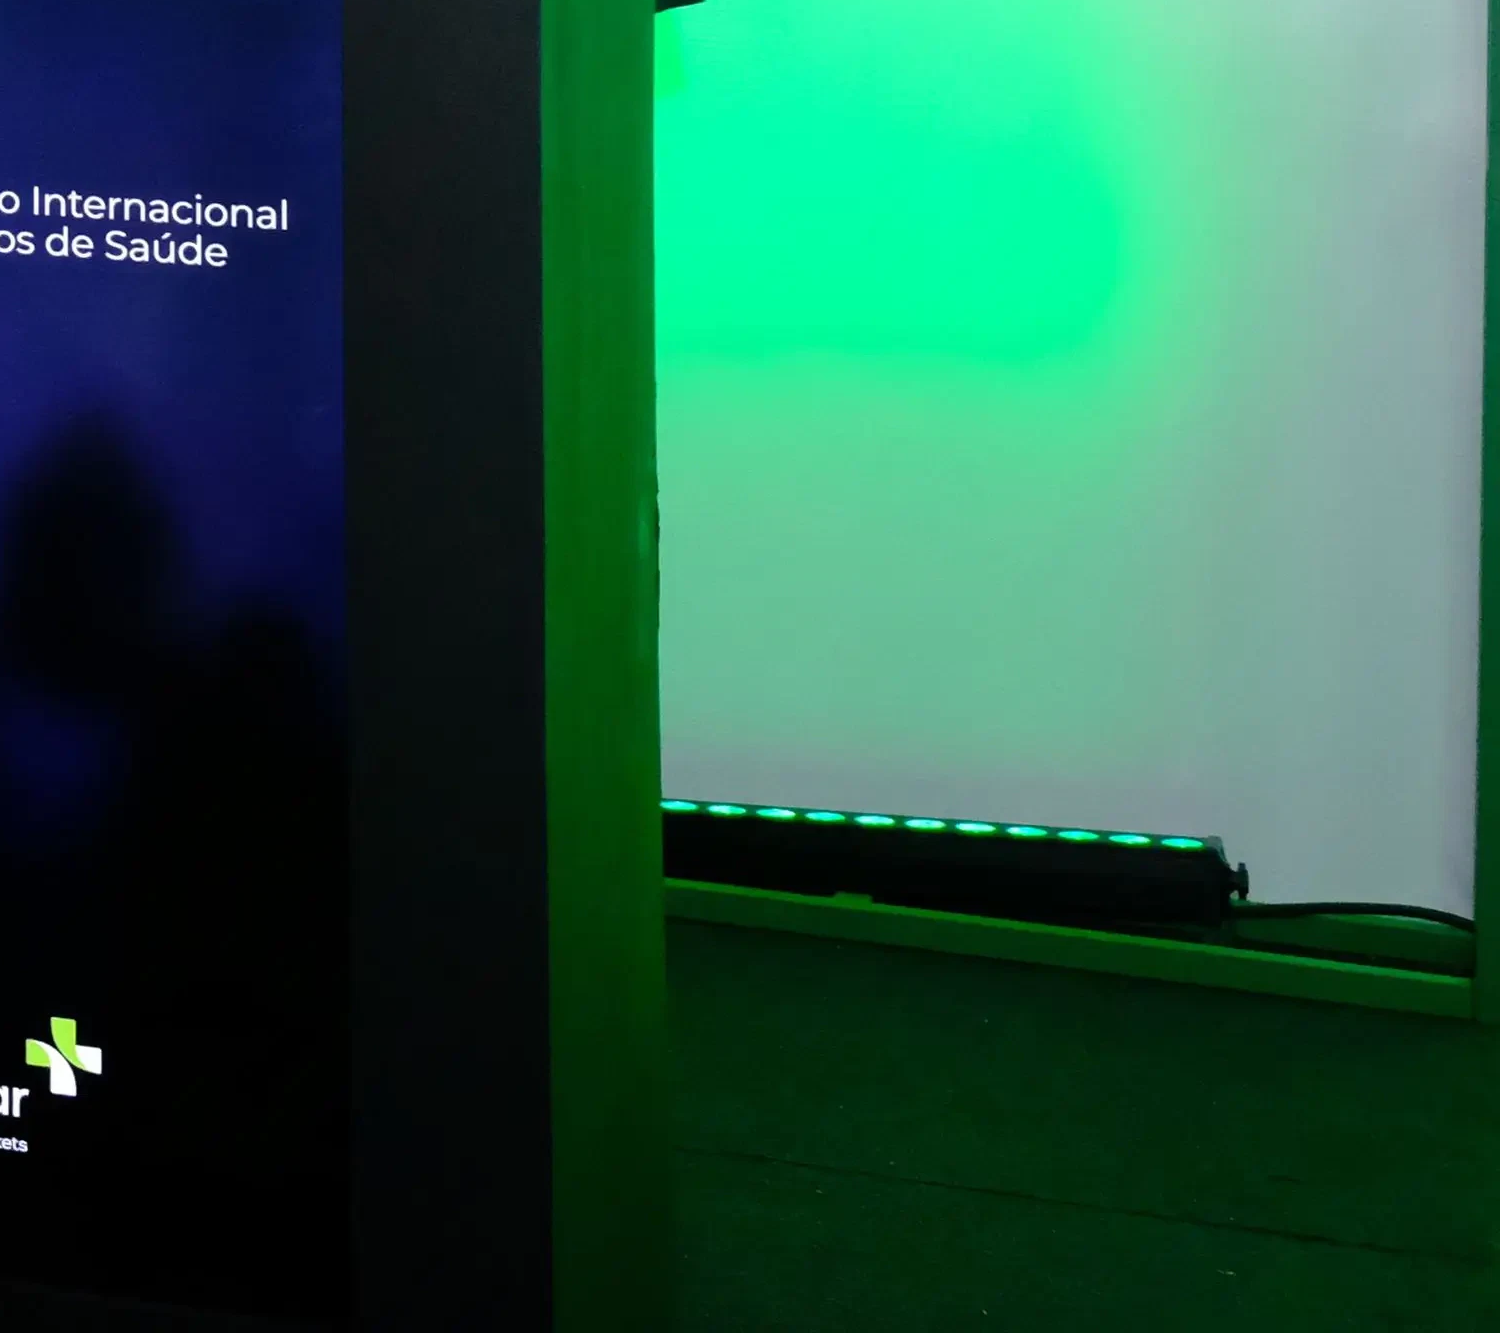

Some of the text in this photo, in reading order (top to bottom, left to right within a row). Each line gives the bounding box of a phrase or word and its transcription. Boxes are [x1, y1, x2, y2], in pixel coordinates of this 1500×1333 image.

[32, 184, 290, 232] Internacional
[45, 224, 94, 259] de
[104, 228, 229, 268] Saúde
